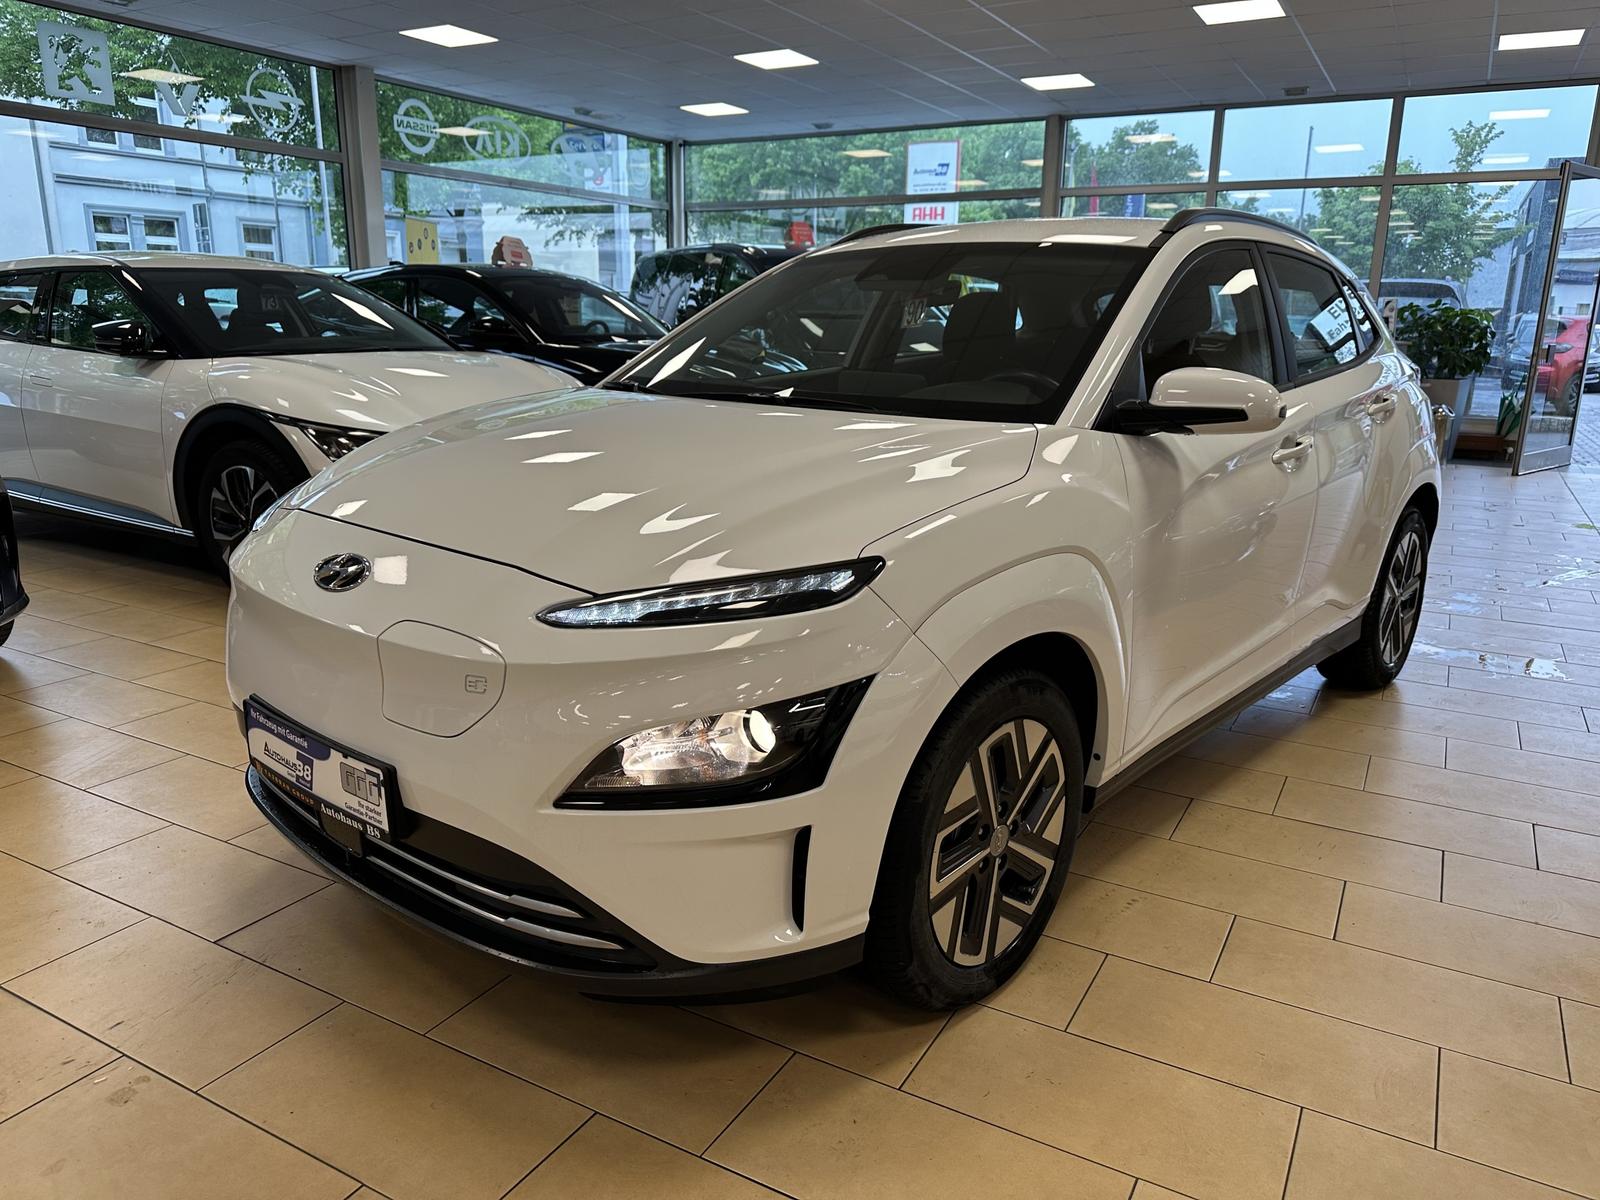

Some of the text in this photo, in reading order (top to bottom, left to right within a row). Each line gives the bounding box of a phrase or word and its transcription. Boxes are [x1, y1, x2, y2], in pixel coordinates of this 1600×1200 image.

[256, 711, 277, 734] Fahrzeug
[277, 726, 286, 736] mit
[285, 729, 308, 749] Garantie
[320, 803, 363, 831] Autohaus
